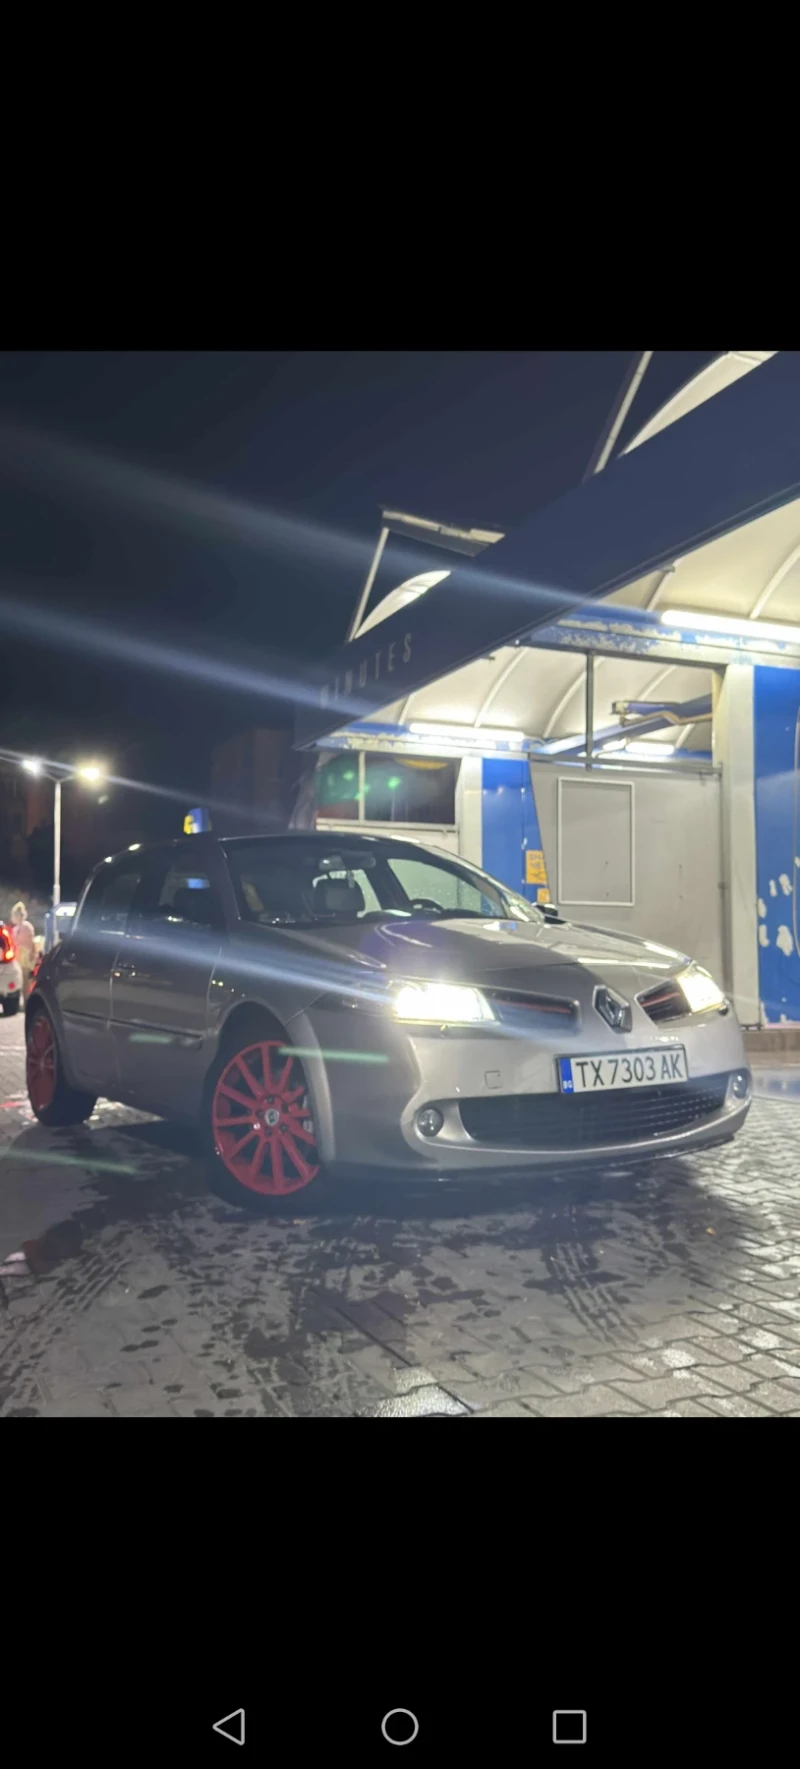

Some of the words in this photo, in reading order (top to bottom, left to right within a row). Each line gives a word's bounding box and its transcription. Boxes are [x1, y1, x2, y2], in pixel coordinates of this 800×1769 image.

[575, 1060, 605, 1088] TX
[607, 1056, 656, 1084] 7303
[660, 1053, 684, 1079] AK
